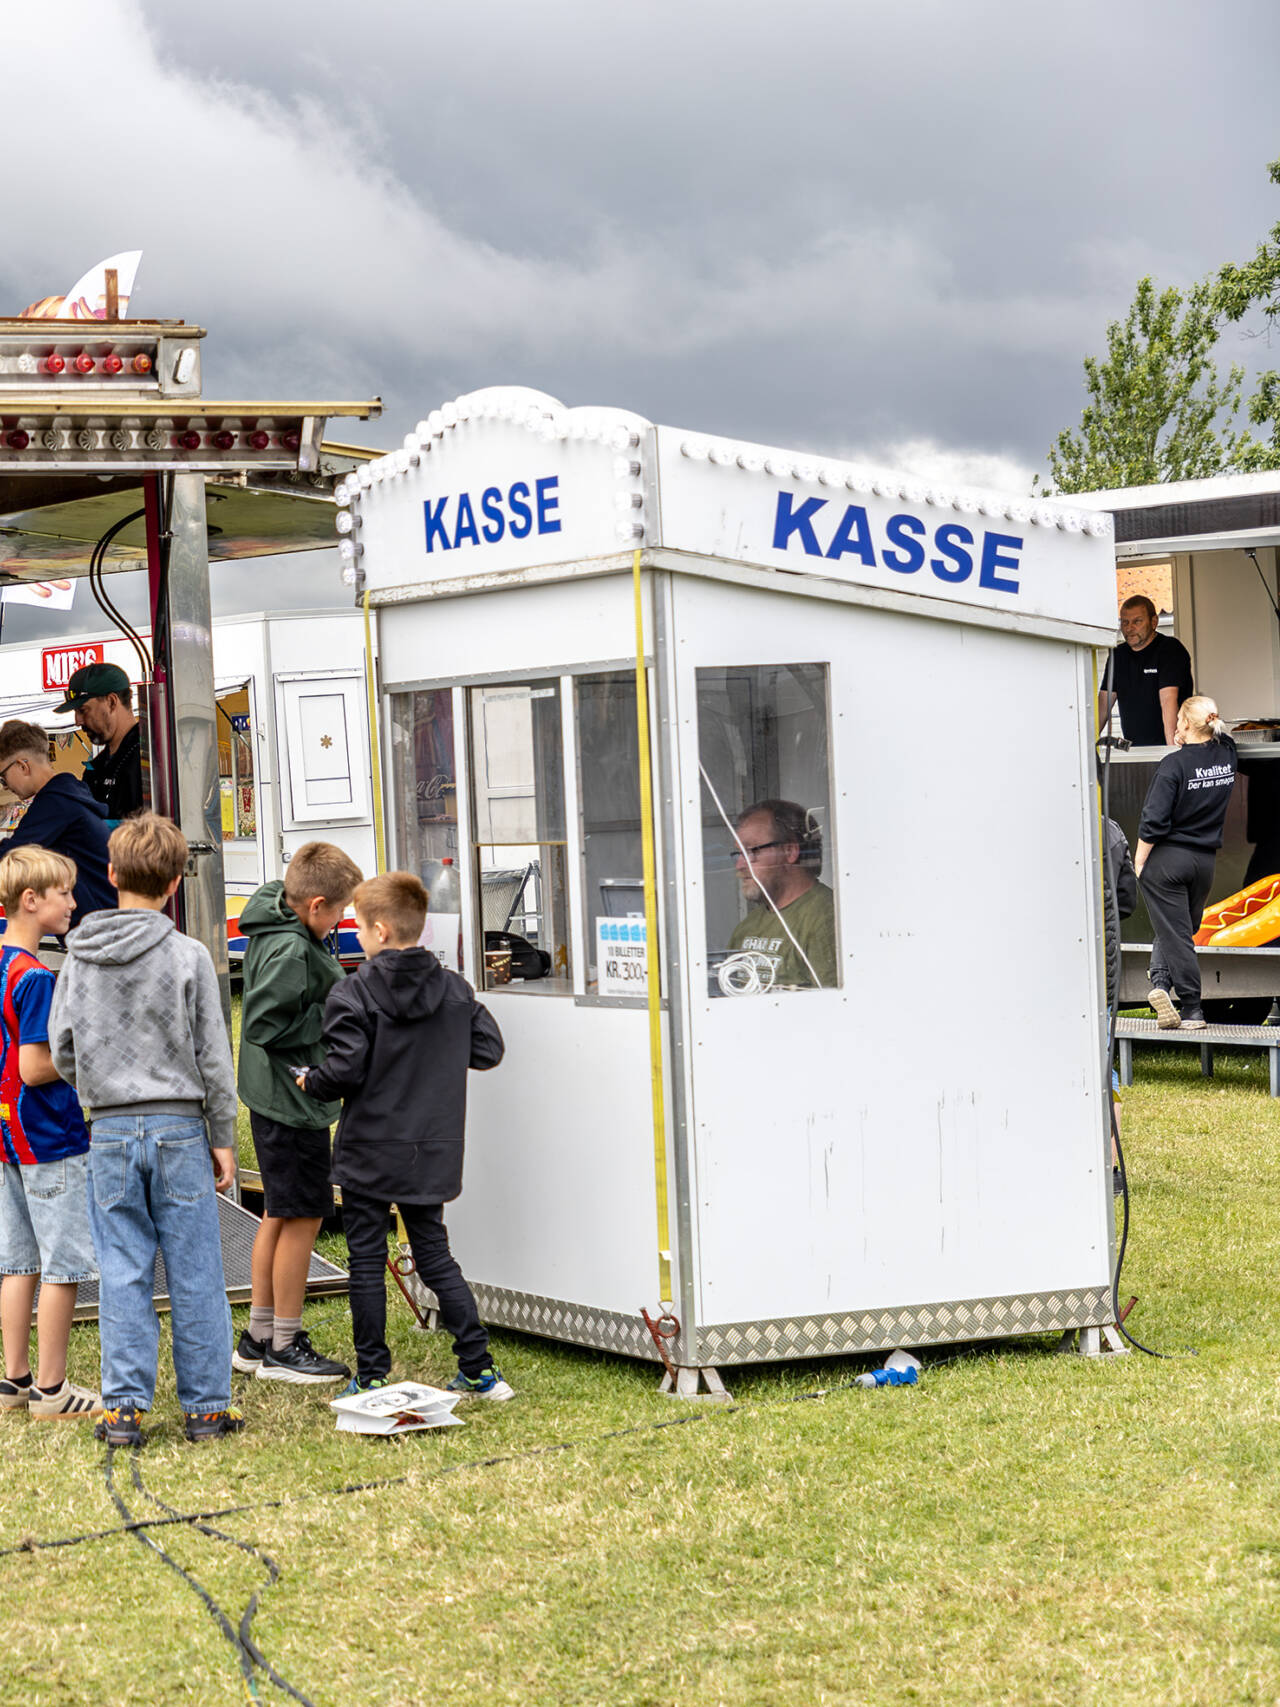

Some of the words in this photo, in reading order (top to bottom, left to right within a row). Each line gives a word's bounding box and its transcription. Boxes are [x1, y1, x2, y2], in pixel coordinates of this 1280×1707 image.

[423, 475, 562, 553] KASSE
[772, 491, 1024, 594] KASSE
[1195, 763, 1232, 778] Kvalitet
[1187, 781, 1201, 790] Der
[1202, 779, 1214, 788] kan
[615, 946, 645, 958] BILLETTER
